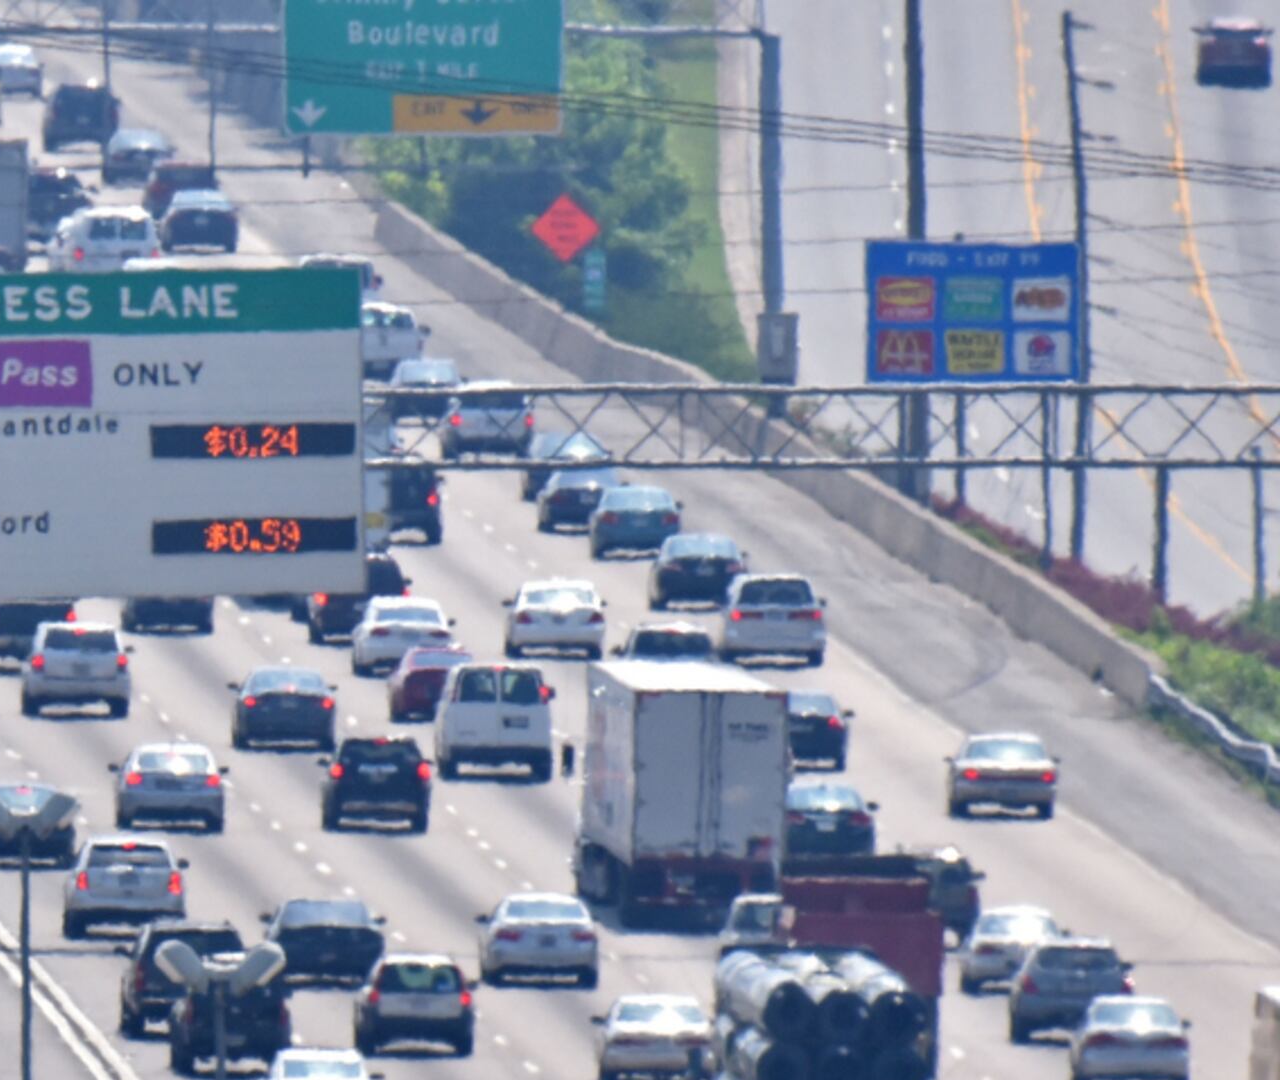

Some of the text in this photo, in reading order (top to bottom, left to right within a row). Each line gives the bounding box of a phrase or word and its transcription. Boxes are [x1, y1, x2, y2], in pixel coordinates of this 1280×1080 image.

[347, 19, 500, 46] Boulevard
[120, 283, 240, 320] LANE
[0, 359, 205, 388] Pass ONLY
[204, 423, 300, 459] $0.24
[204, 519, 301, 553] $0.59
